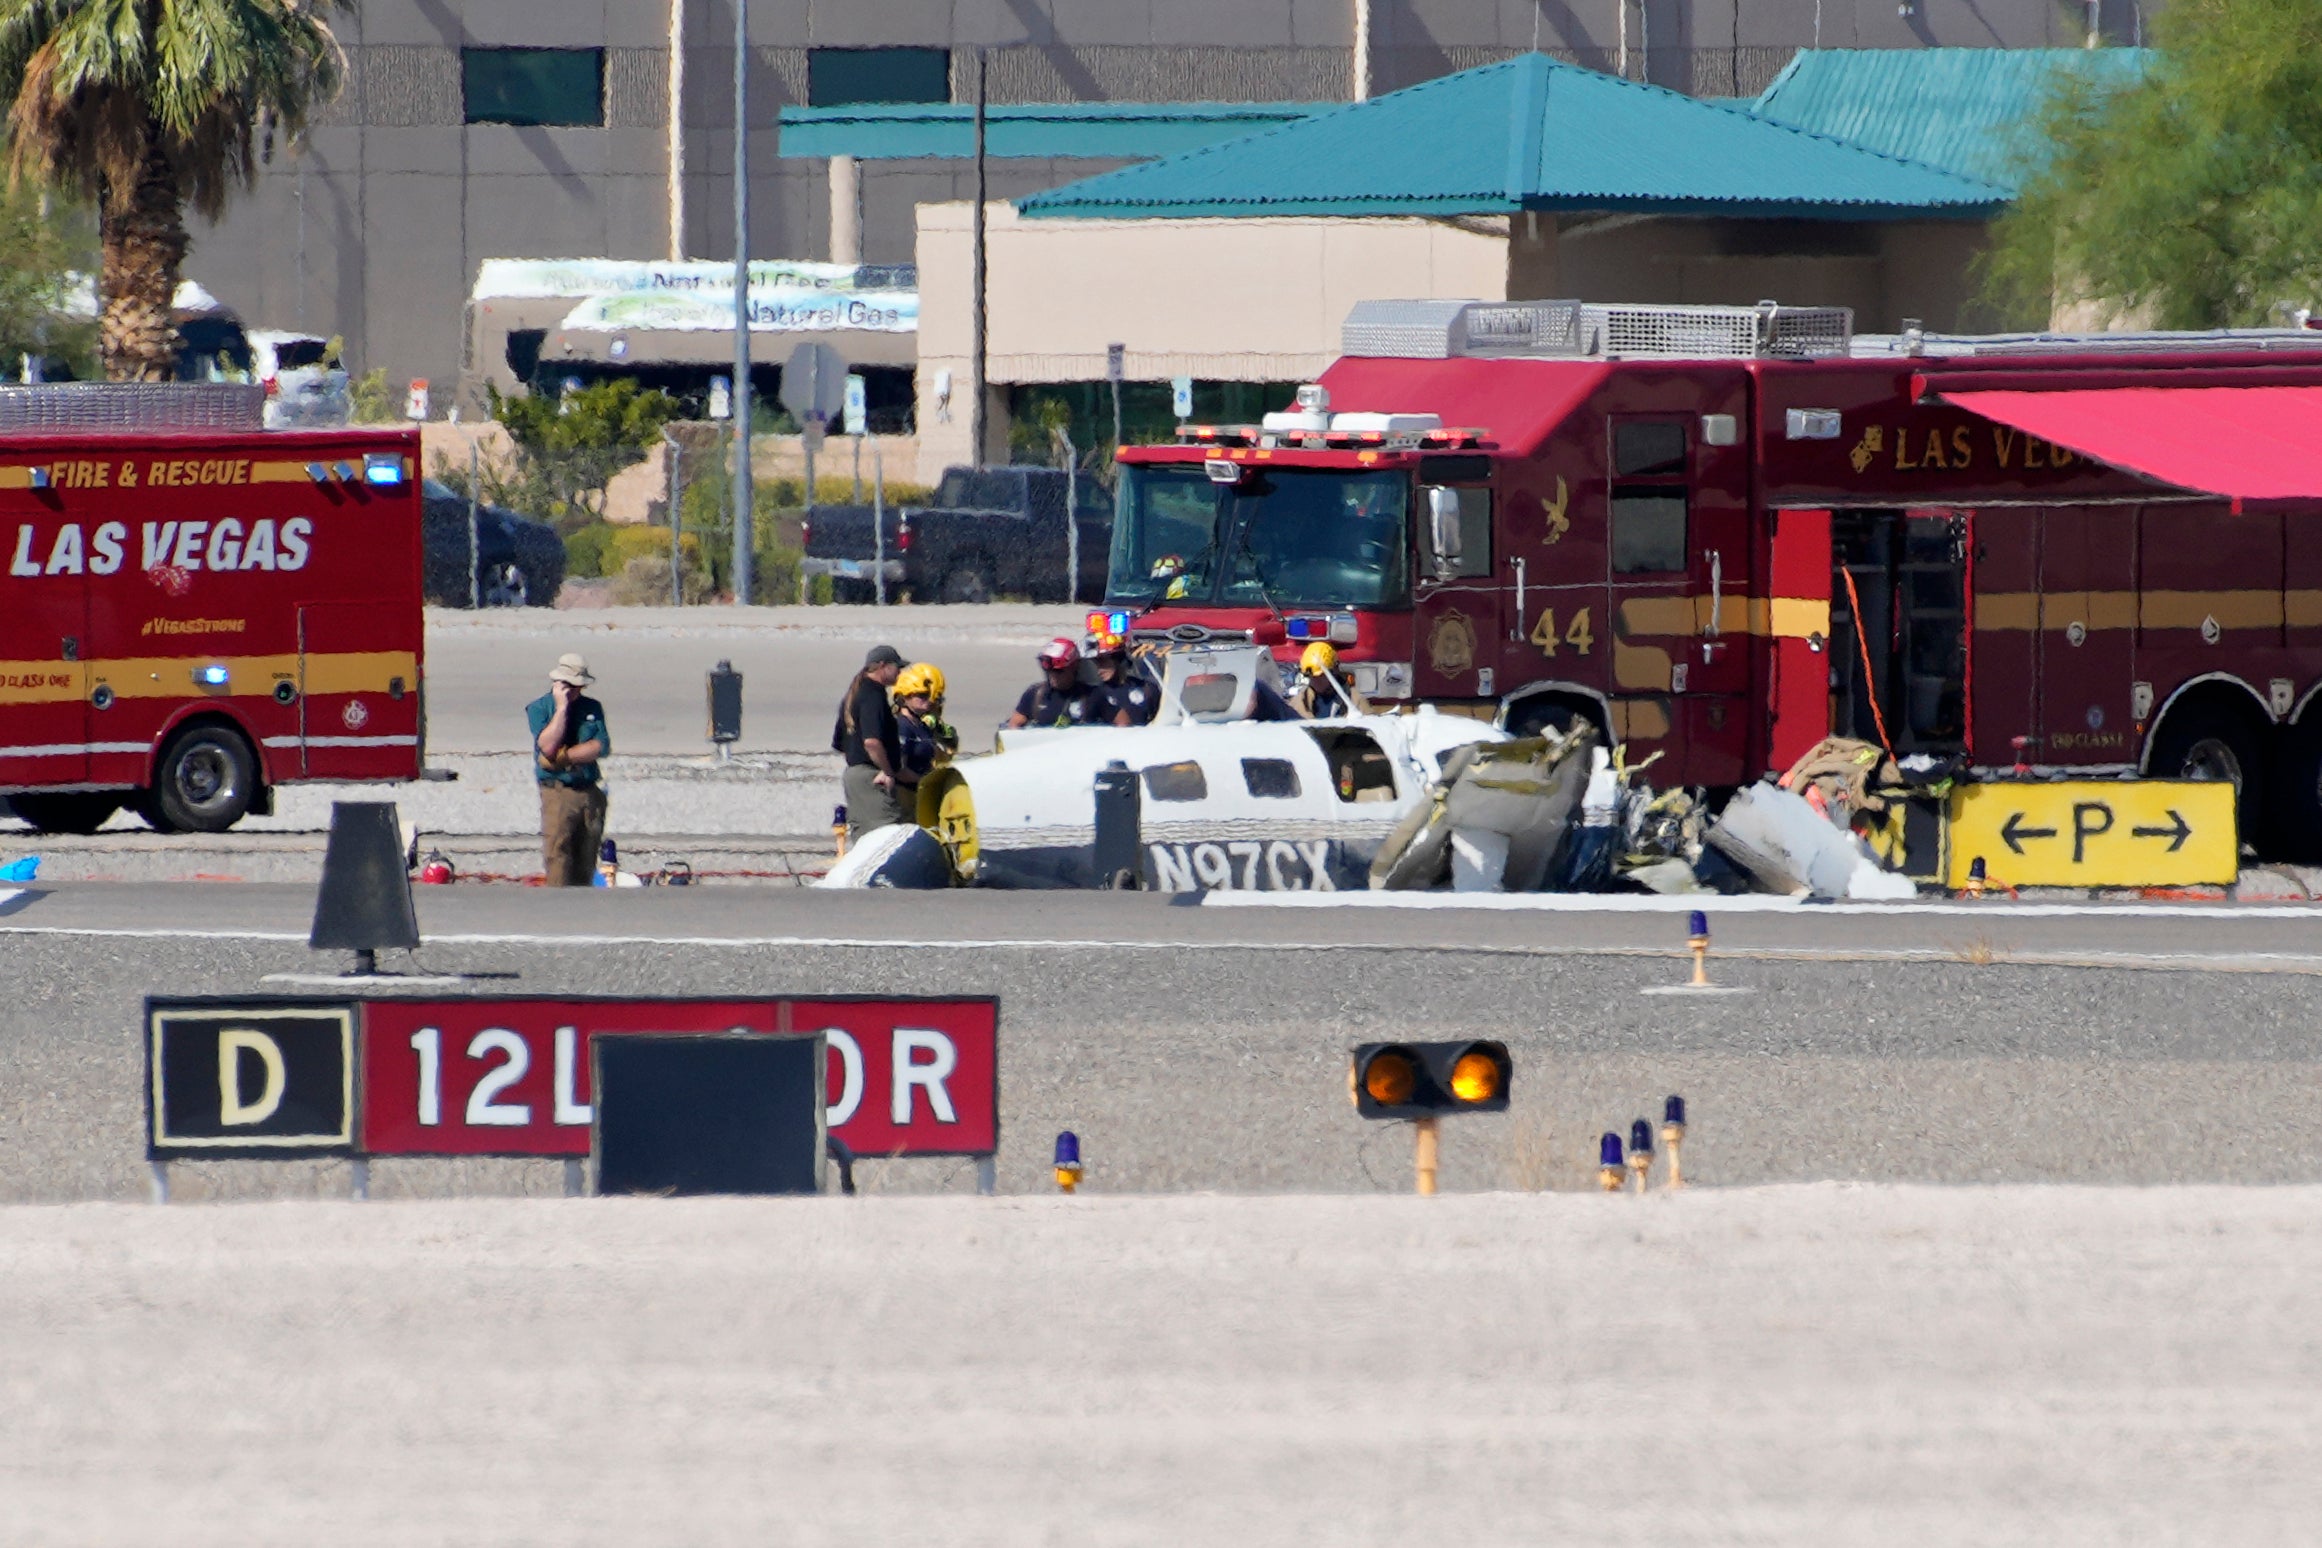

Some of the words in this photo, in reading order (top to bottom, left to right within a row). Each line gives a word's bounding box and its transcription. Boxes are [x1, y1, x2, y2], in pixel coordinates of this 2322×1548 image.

[848, 301, 899, 325] Gas
[51, 460, 111, 488] FIRE
[117, 460, 139, 488] &
[147, 458, 250, 487] RESCUE
[1894, 426, 1972, 470] LAS
[8, 520, 128, 577] LAS
[140, 516, 315, 572] VEGAS
[1530, 607, 1595, 657] 44
[2071, 801, 2115, 864] P
[1150, 839, 1337, 893] N97CX
[217, 1028, 287, 1127] D
